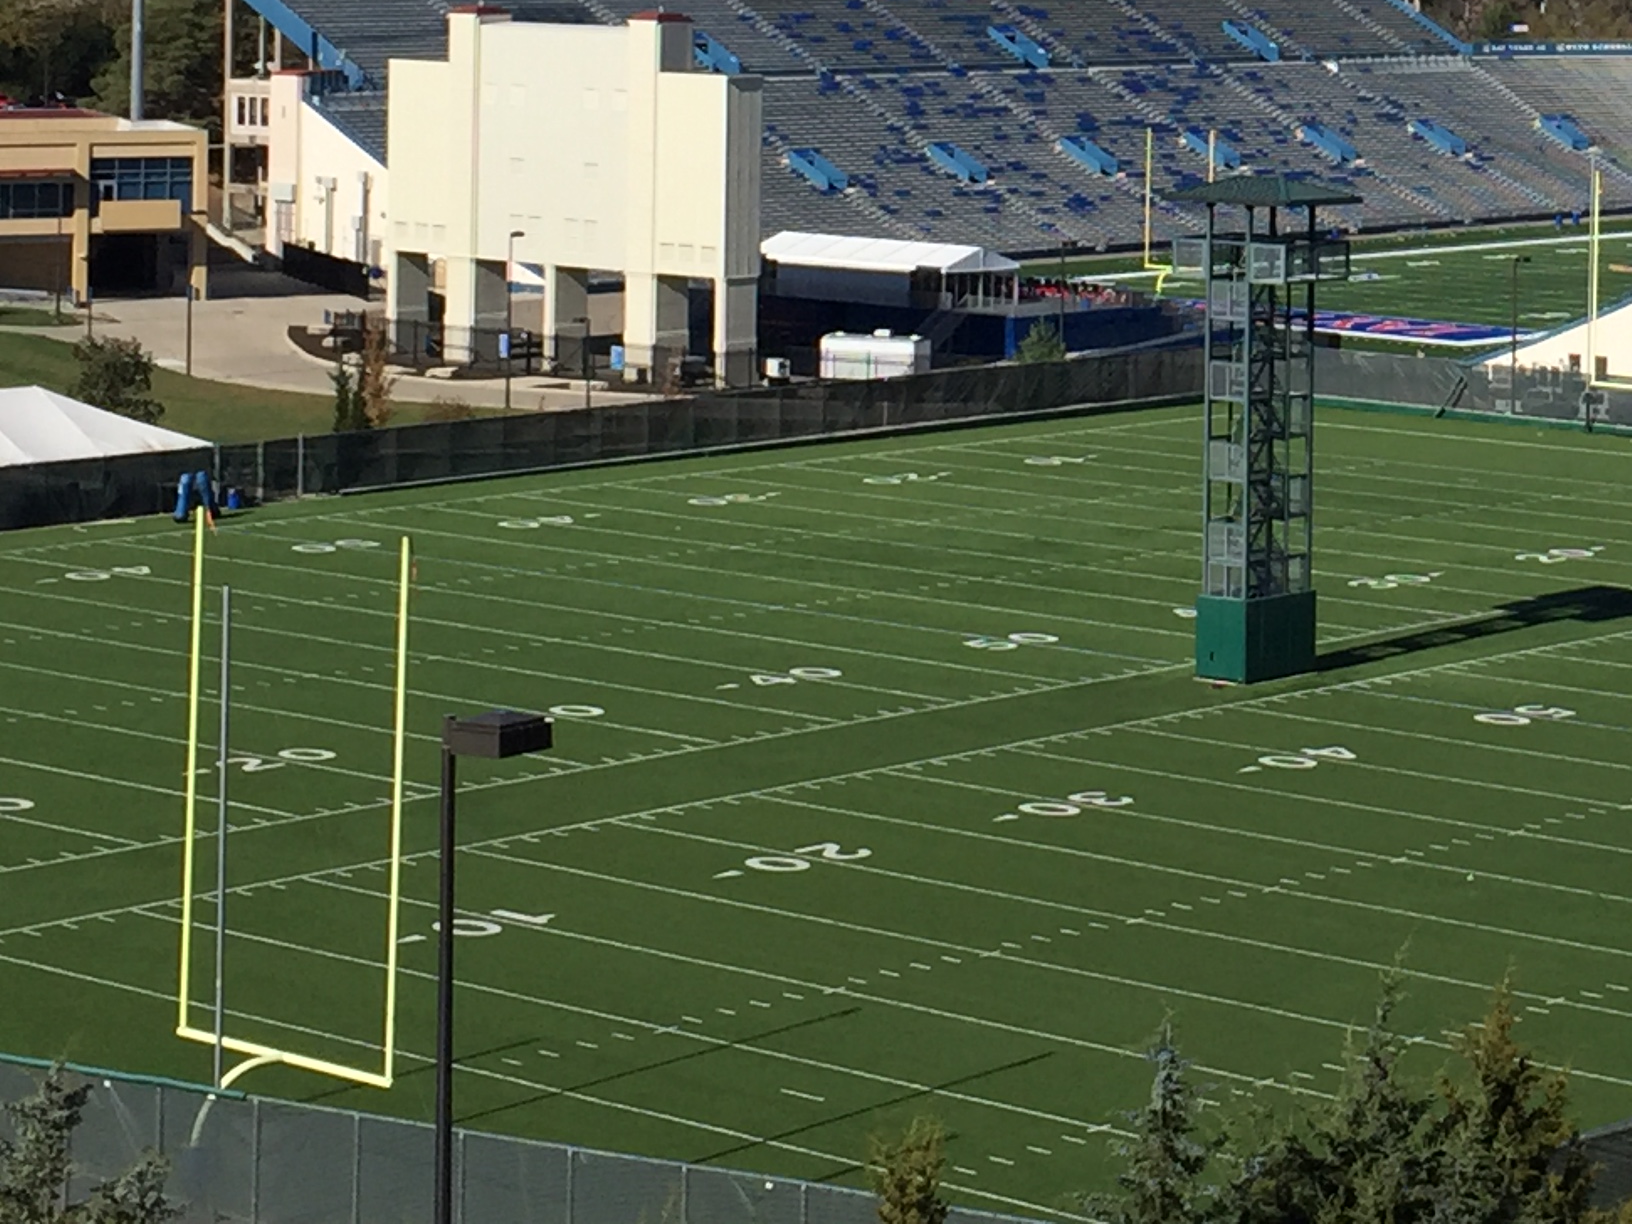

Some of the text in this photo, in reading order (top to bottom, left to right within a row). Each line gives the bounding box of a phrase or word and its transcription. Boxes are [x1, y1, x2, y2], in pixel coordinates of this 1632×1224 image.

[749, 667, 842, 686] 40
[215, 747, 336, 773] 20
[1258, 745, 1358, 770] 40
[1018, 791, 1135, 817] 30
[744, 842, 873, 873] 20
